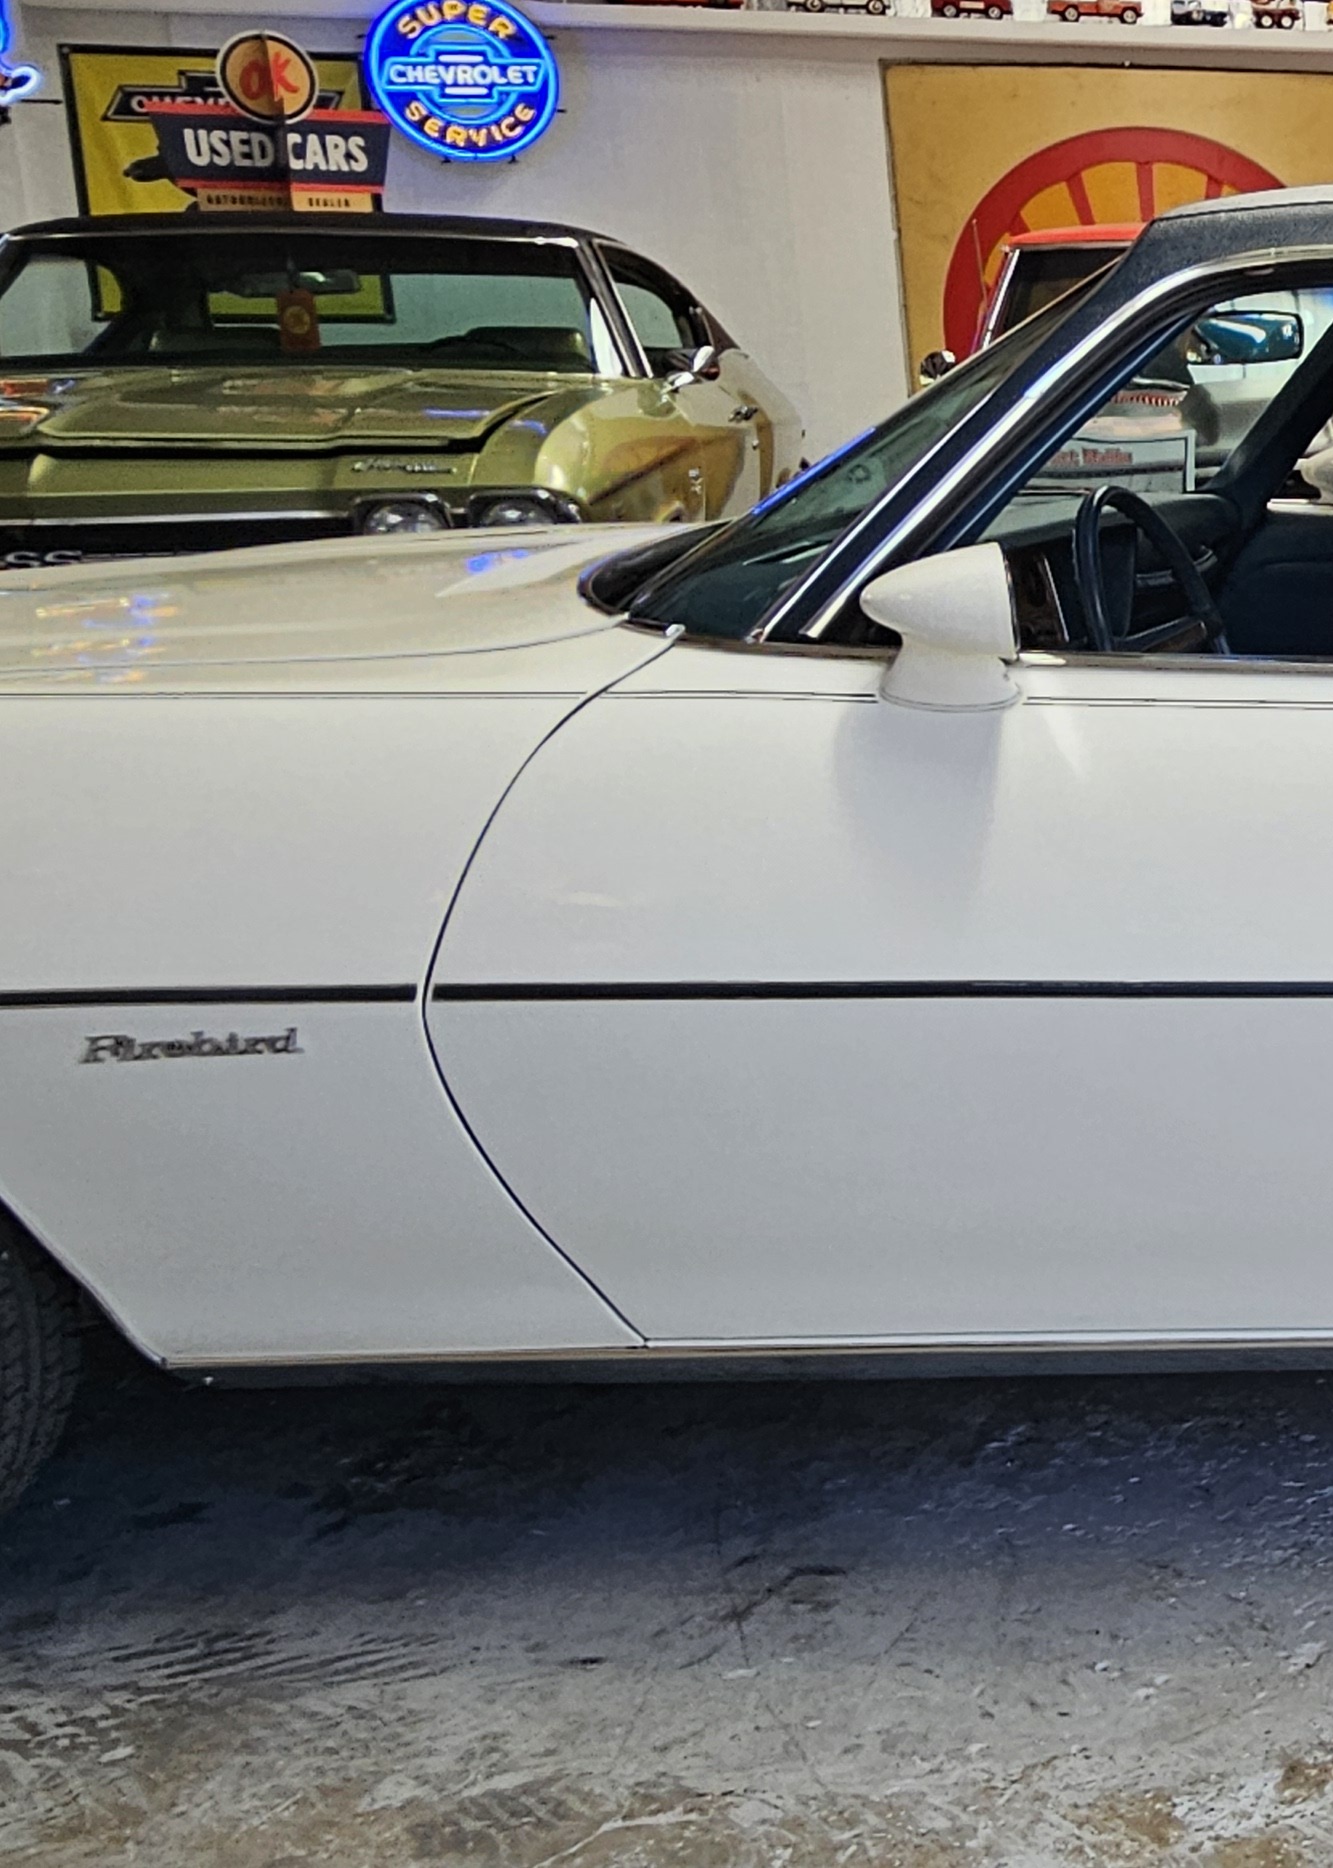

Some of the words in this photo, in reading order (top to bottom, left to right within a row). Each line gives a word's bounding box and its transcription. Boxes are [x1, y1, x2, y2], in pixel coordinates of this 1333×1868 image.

[397, 0, 517, 39] SUPER
[238, 51, 300, 102] OK
[389, 63, 539, 85] CHEVROLET
[404, 100, 537, 147] SERVICE
[182, 127, 276, 168] USED
[286, 132, 369, 173] CARS
[78, 1027, 305, 1065] Firebird
